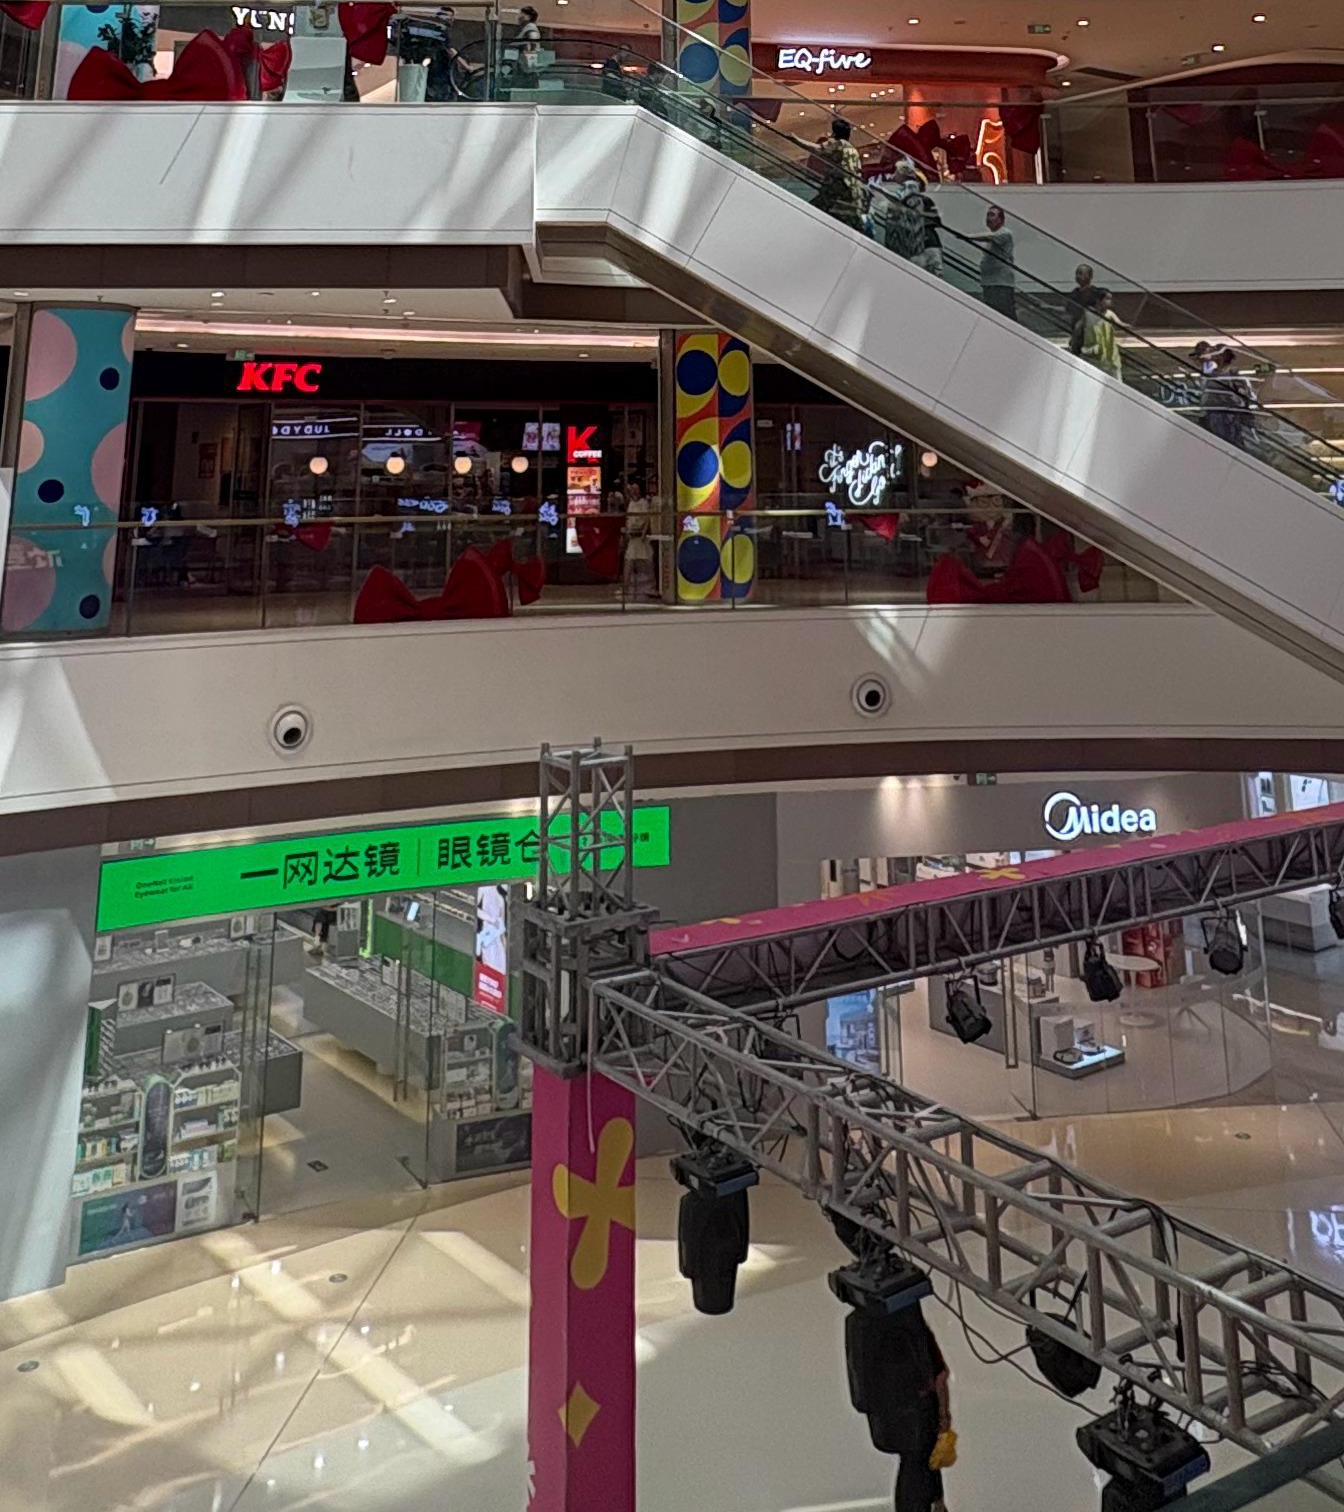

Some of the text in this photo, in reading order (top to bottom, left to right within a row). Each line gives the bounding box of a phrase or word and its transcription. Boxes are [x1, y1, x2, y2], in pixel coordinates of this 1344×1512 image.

[237, 362, 322, 392] KFC
[1051, 796, 1156, 837] Midea
[239, 845, 401, 889] 一网达镜
